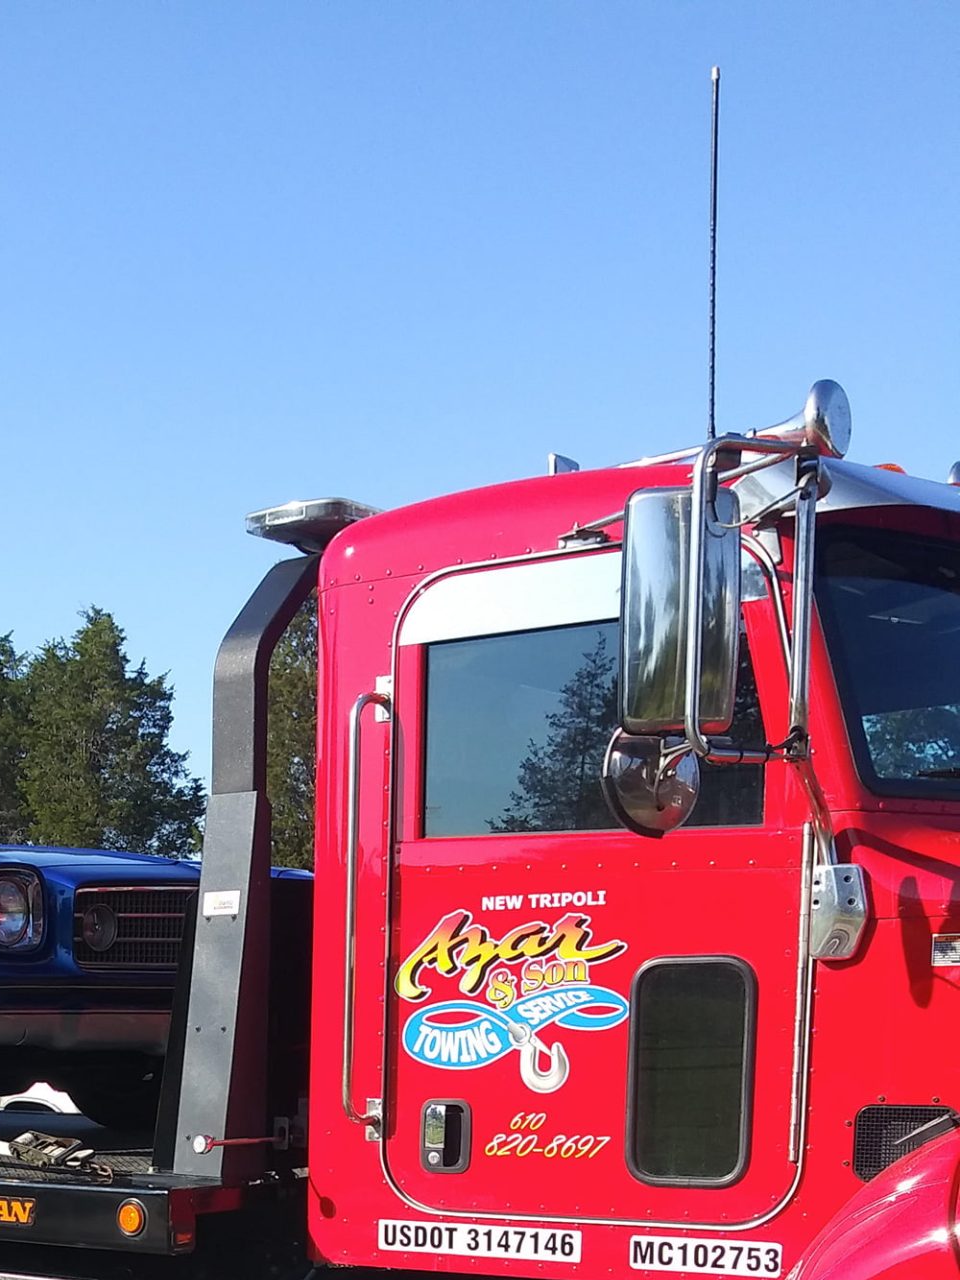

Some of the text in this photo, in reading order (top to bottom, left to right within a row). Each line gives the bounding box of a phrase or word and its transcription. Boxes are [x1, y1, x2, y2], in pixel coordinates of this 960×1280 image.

[481, 890, 606, 911] NEW TRIPOLI
[488, 960, 588, 1008] & Son
[413, 990, 594, 1063] TOWING SERVICE
[510, 1112, 547, 1130] 610
[485, 1133, 611, 1158] 820-8697
[383, 1223, 574, 1257] USDOT 3147146
[632, 1239, 780, 1273] MC102753
